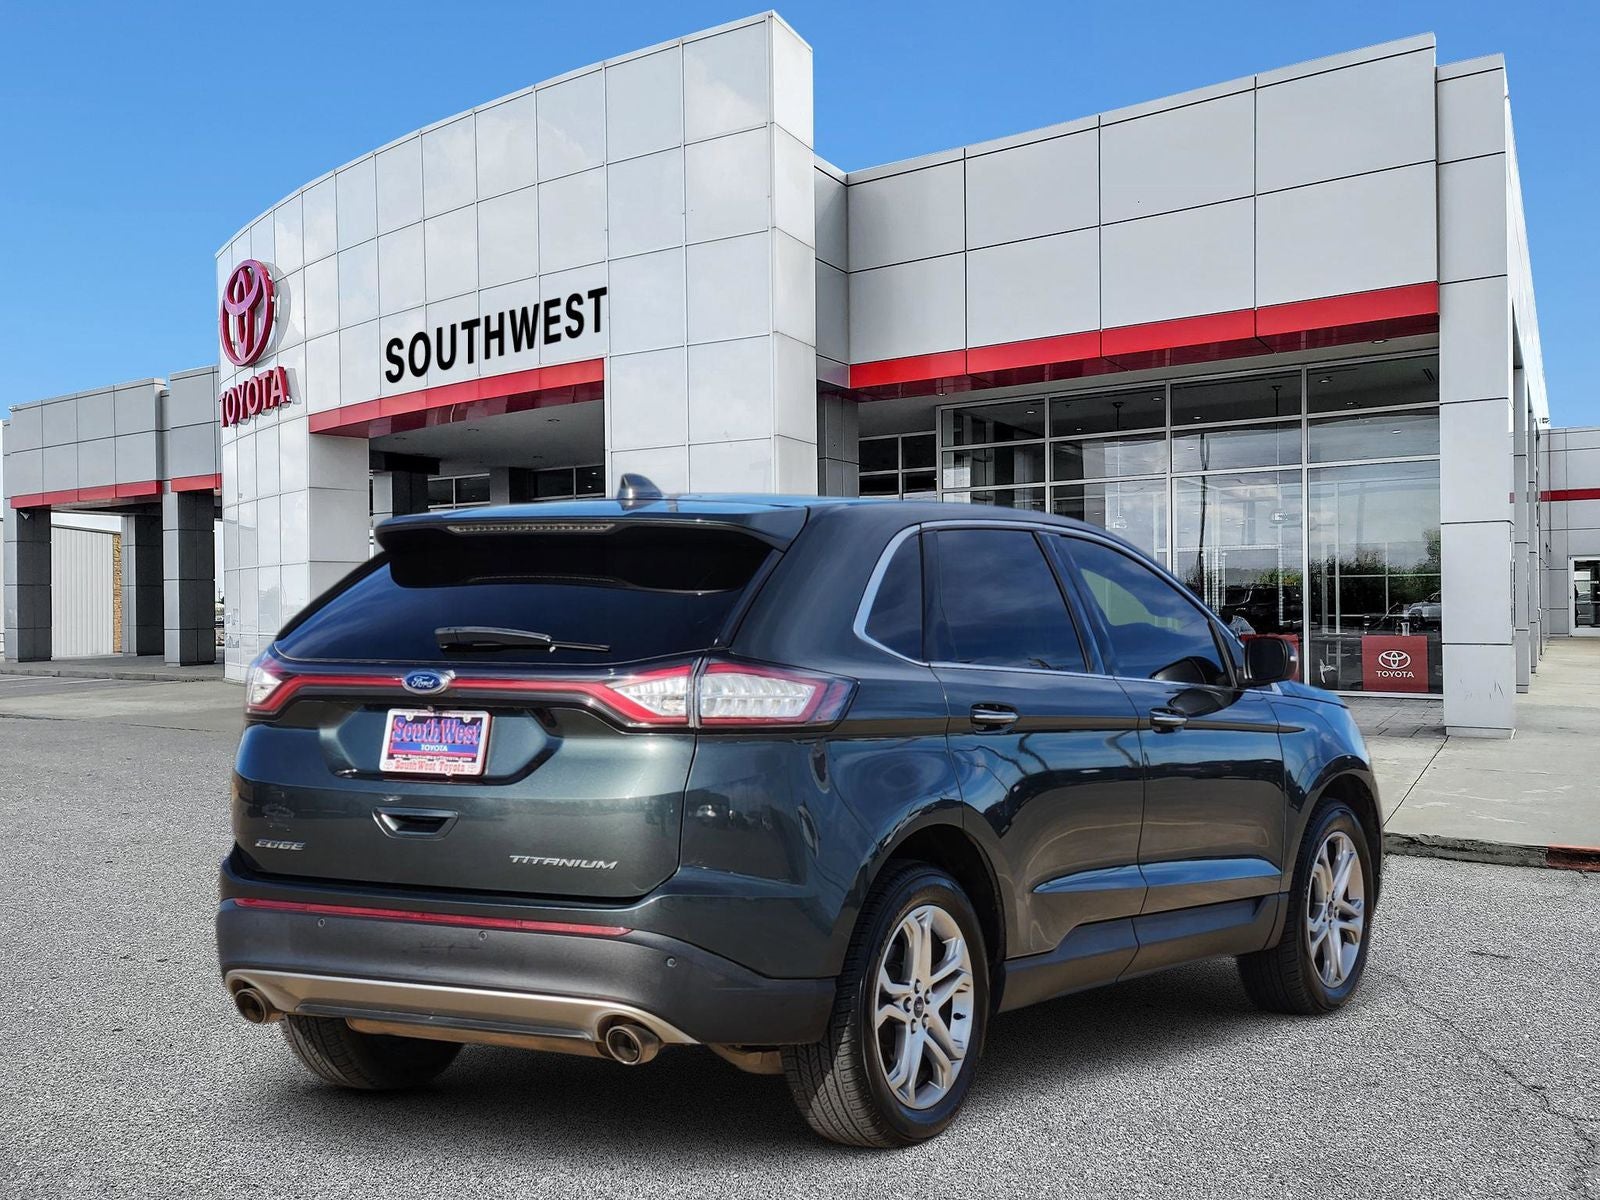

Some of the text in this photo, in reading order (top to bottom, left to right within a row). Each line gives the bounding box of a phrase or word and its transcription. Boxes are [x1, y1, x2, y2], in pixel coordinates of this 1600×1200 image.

[385, 286, 608, 384] SOUTHWEST
[219, 366, 290, 428] TOYOTA
[1376, 670, 1414, 678] TOYOTA
[411, 675, 434, 688] Ford
[421, 744, 448, 752] TOYOTA
[254, 839, 305, 851] EDGE
[509, 855, 618, 870] TITANIUM
